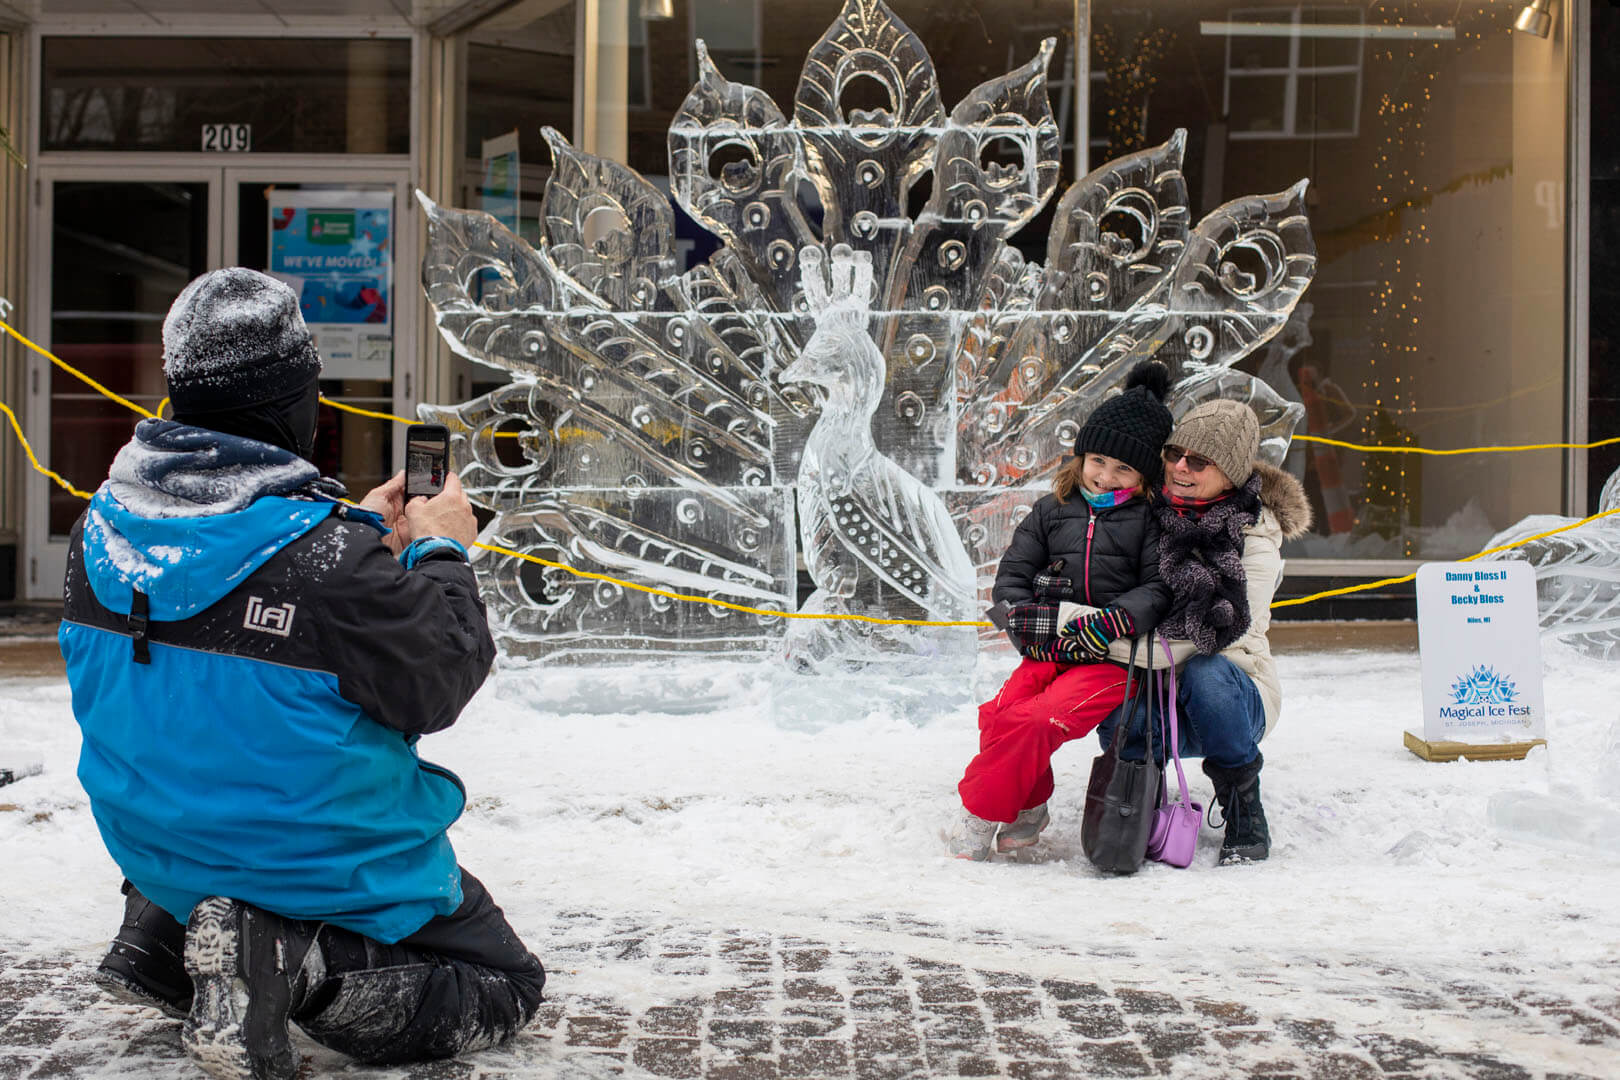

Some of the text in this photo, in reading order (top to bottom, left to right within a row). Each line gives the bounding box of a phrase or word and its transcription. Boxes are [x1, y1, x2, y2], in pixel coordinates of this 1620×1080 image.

[206, 126, 247, 150] 209
[283, 255, 377, 268] WE'VE MOVED!
[1446, 571, 1473, 582] Danny
[1475, 571, 1499, 581] Bloss
[1474, 584, 1480, 592] &
[1451, 594, 1505, 605] Becky Bloss
[1439, 704, 1531, 721] Magical Ice Fest
